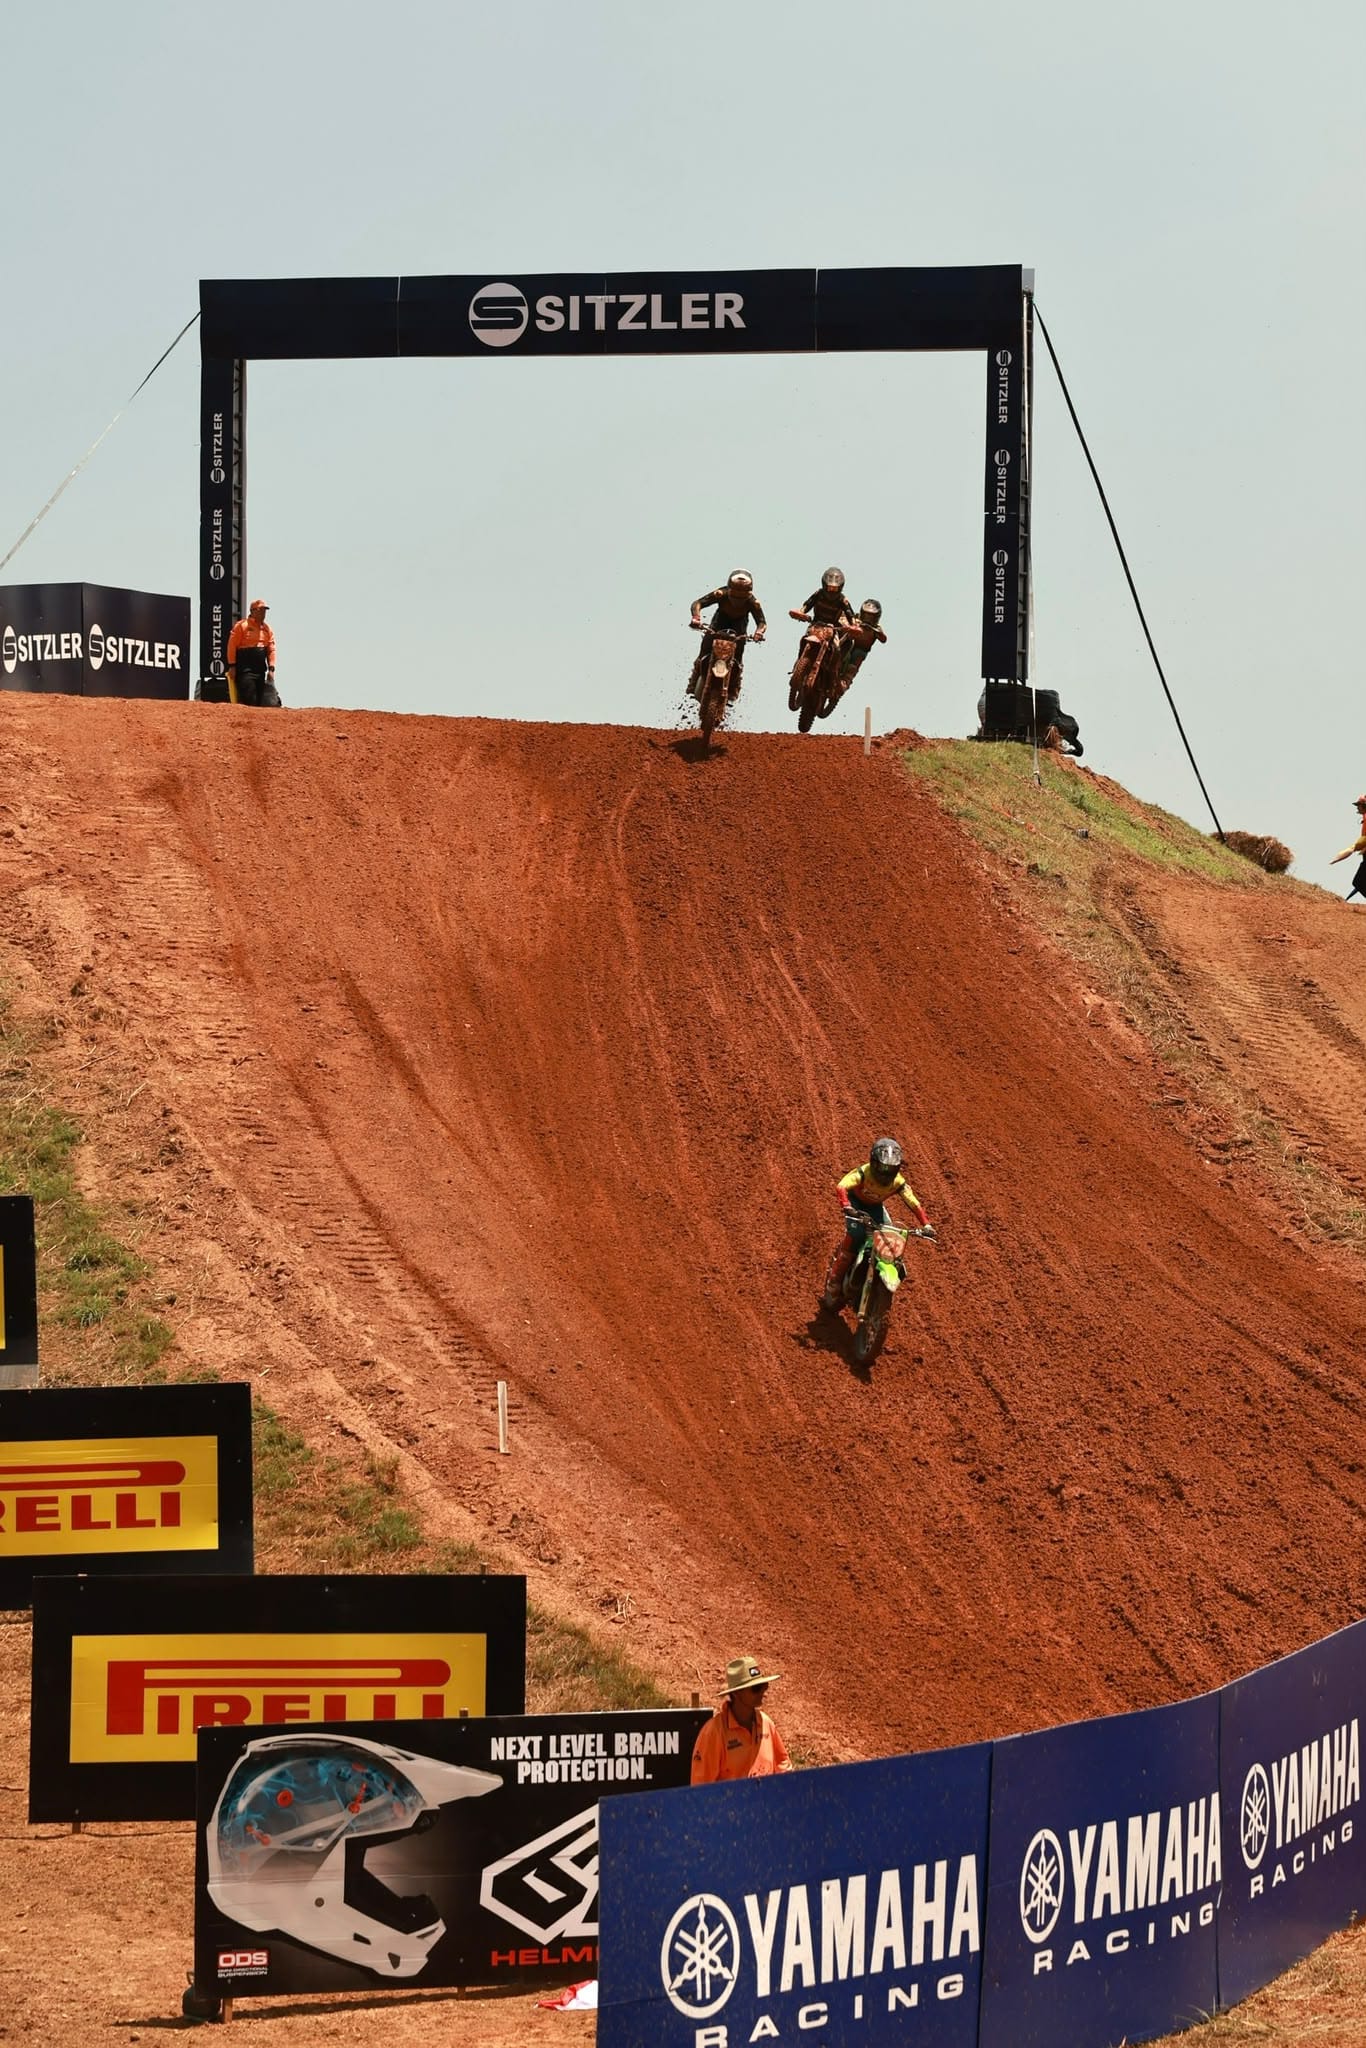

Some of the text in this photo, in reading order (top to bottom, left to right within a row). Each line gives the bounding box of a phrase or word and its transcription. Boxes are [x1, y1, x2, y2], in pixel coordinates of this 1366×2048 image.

[535, 292, 747, 332] SITZLER
[998, 366, 1009, 424] SITZLER
[213, 412, 223, 467] SITZLER
[995, 466, 1007, 524] SITZLER
[212, 508, 223, 563] SITZLER
[994, 565, 1005, 624] SITZLER
[17, 632, 84, 663] SITZLER
[105, 635, 181, 670] SITZLER
[212, 604, 222, 659] SITZLER
[490, 1731, 680, 1761] NEXT LEVEL BRAIN
[517, 1757, 653, 1784] PROTECTION.
[1271, 1718, 1361, 1849] YAMAHA
[1068, 1791, 1223, 1925] YAMAHA
[1249, 1820, 1354, 1899] RACING
[743, 1853, 981, 1998] YAMAHA
[1033, 1902, 1214, 1976] RACING
[218, 1951, 268, 1967] ODS
[491, 1945, 599, 1967] HELM
[695, 1973, 965, 2048] RACING
